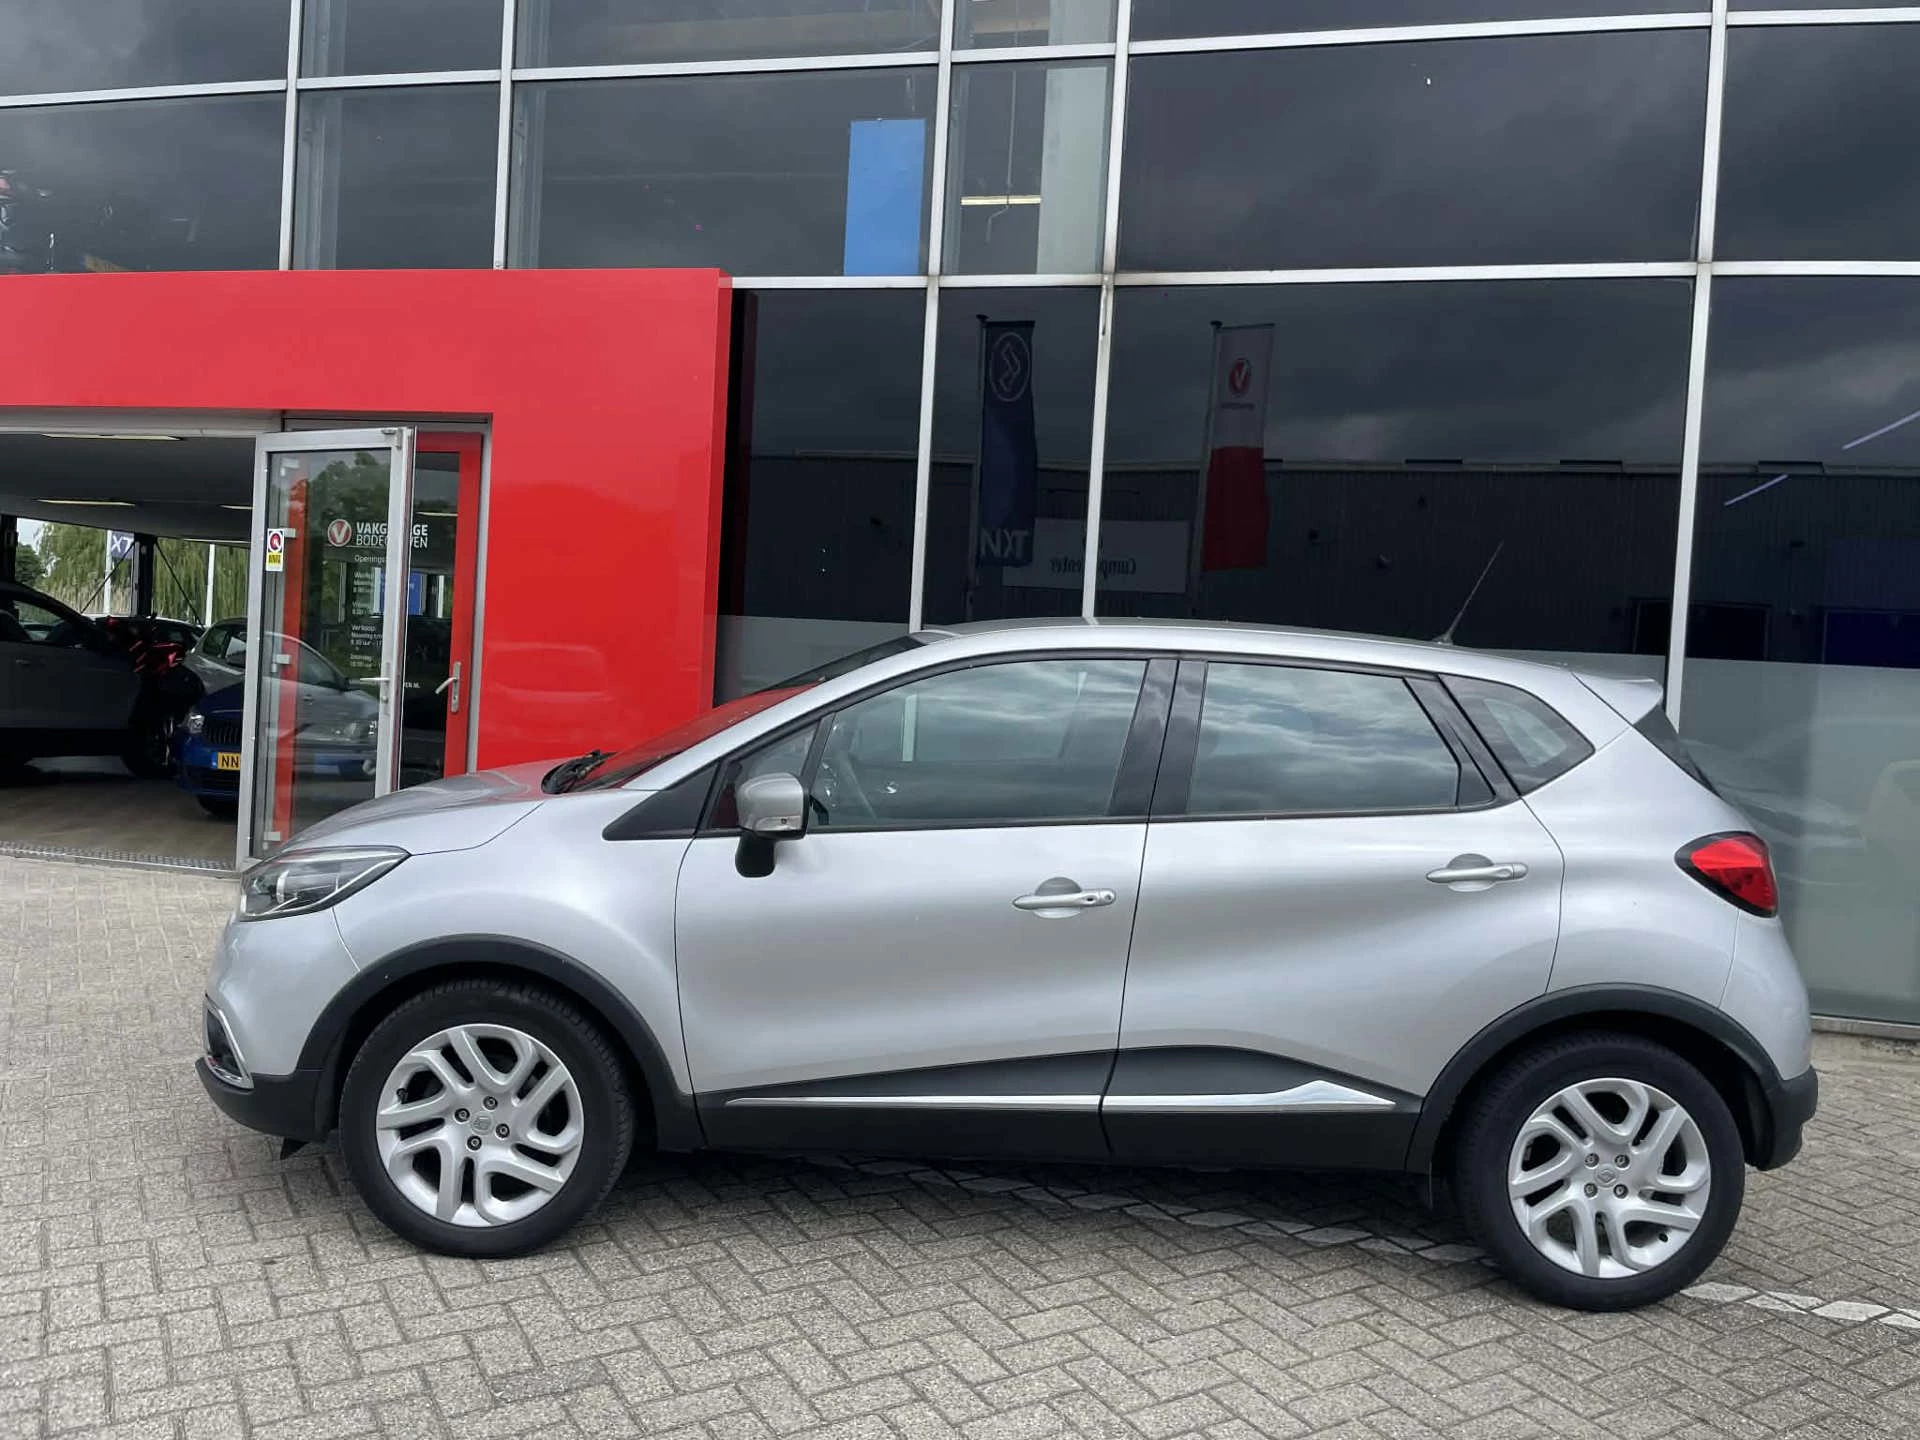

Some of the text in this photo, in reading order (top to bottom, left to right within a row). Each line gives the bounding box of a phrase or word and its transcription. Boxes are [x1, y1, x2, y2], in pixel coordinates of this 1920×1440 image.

[356, 522, 428, 536] VAKGGE
[356, 534, 428, 548] BODEEN
[980, 528, 1029, 560] NXT
